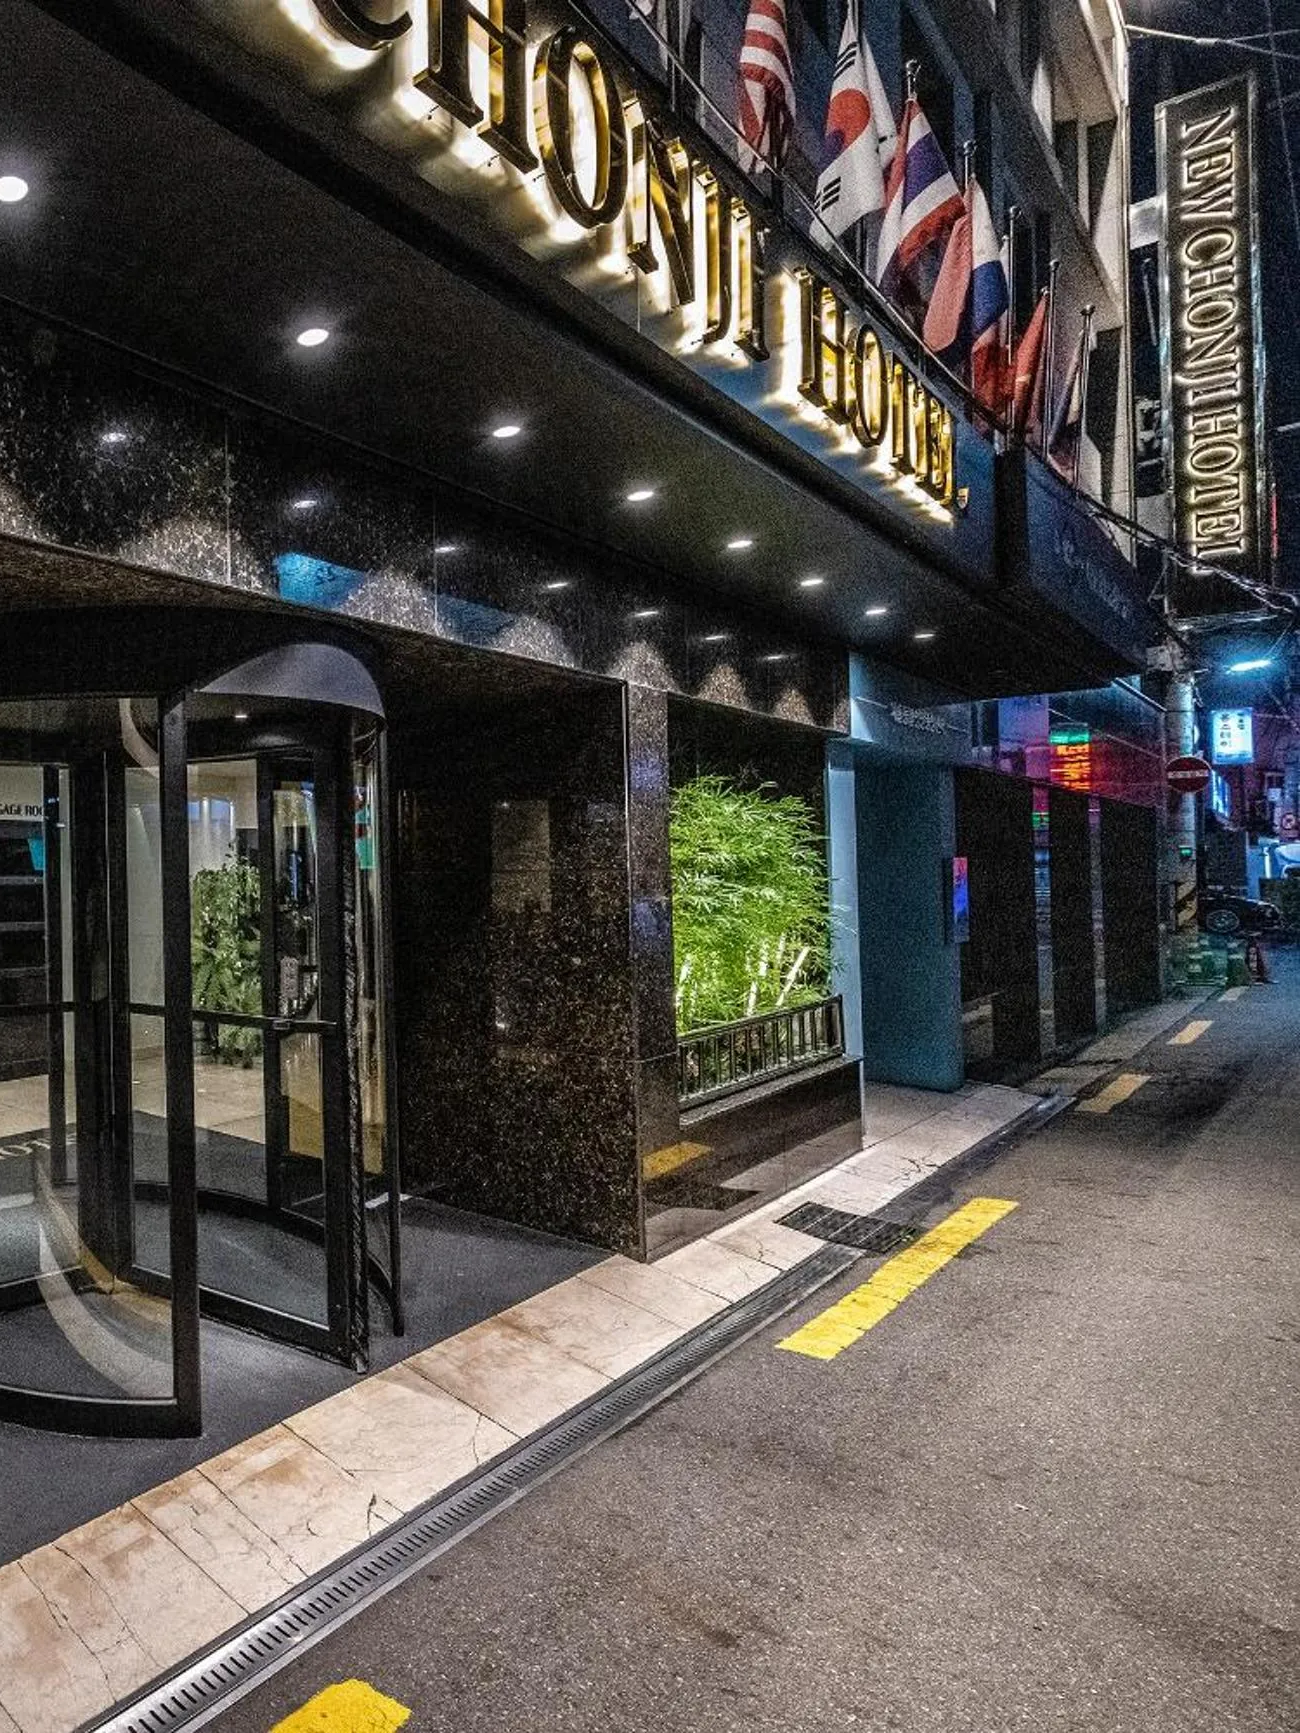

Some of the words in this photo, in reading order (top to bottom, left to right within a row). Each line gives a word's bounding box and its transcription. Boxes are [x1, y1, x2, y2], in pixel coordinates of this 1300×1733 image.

[1180, 106, 1238, 220] NEW
[795, 265, 969, 514] HOTEL
[1175, 226, 1241, 401] CHONJI
[1188, 407, 1245, 575] HOTEL
